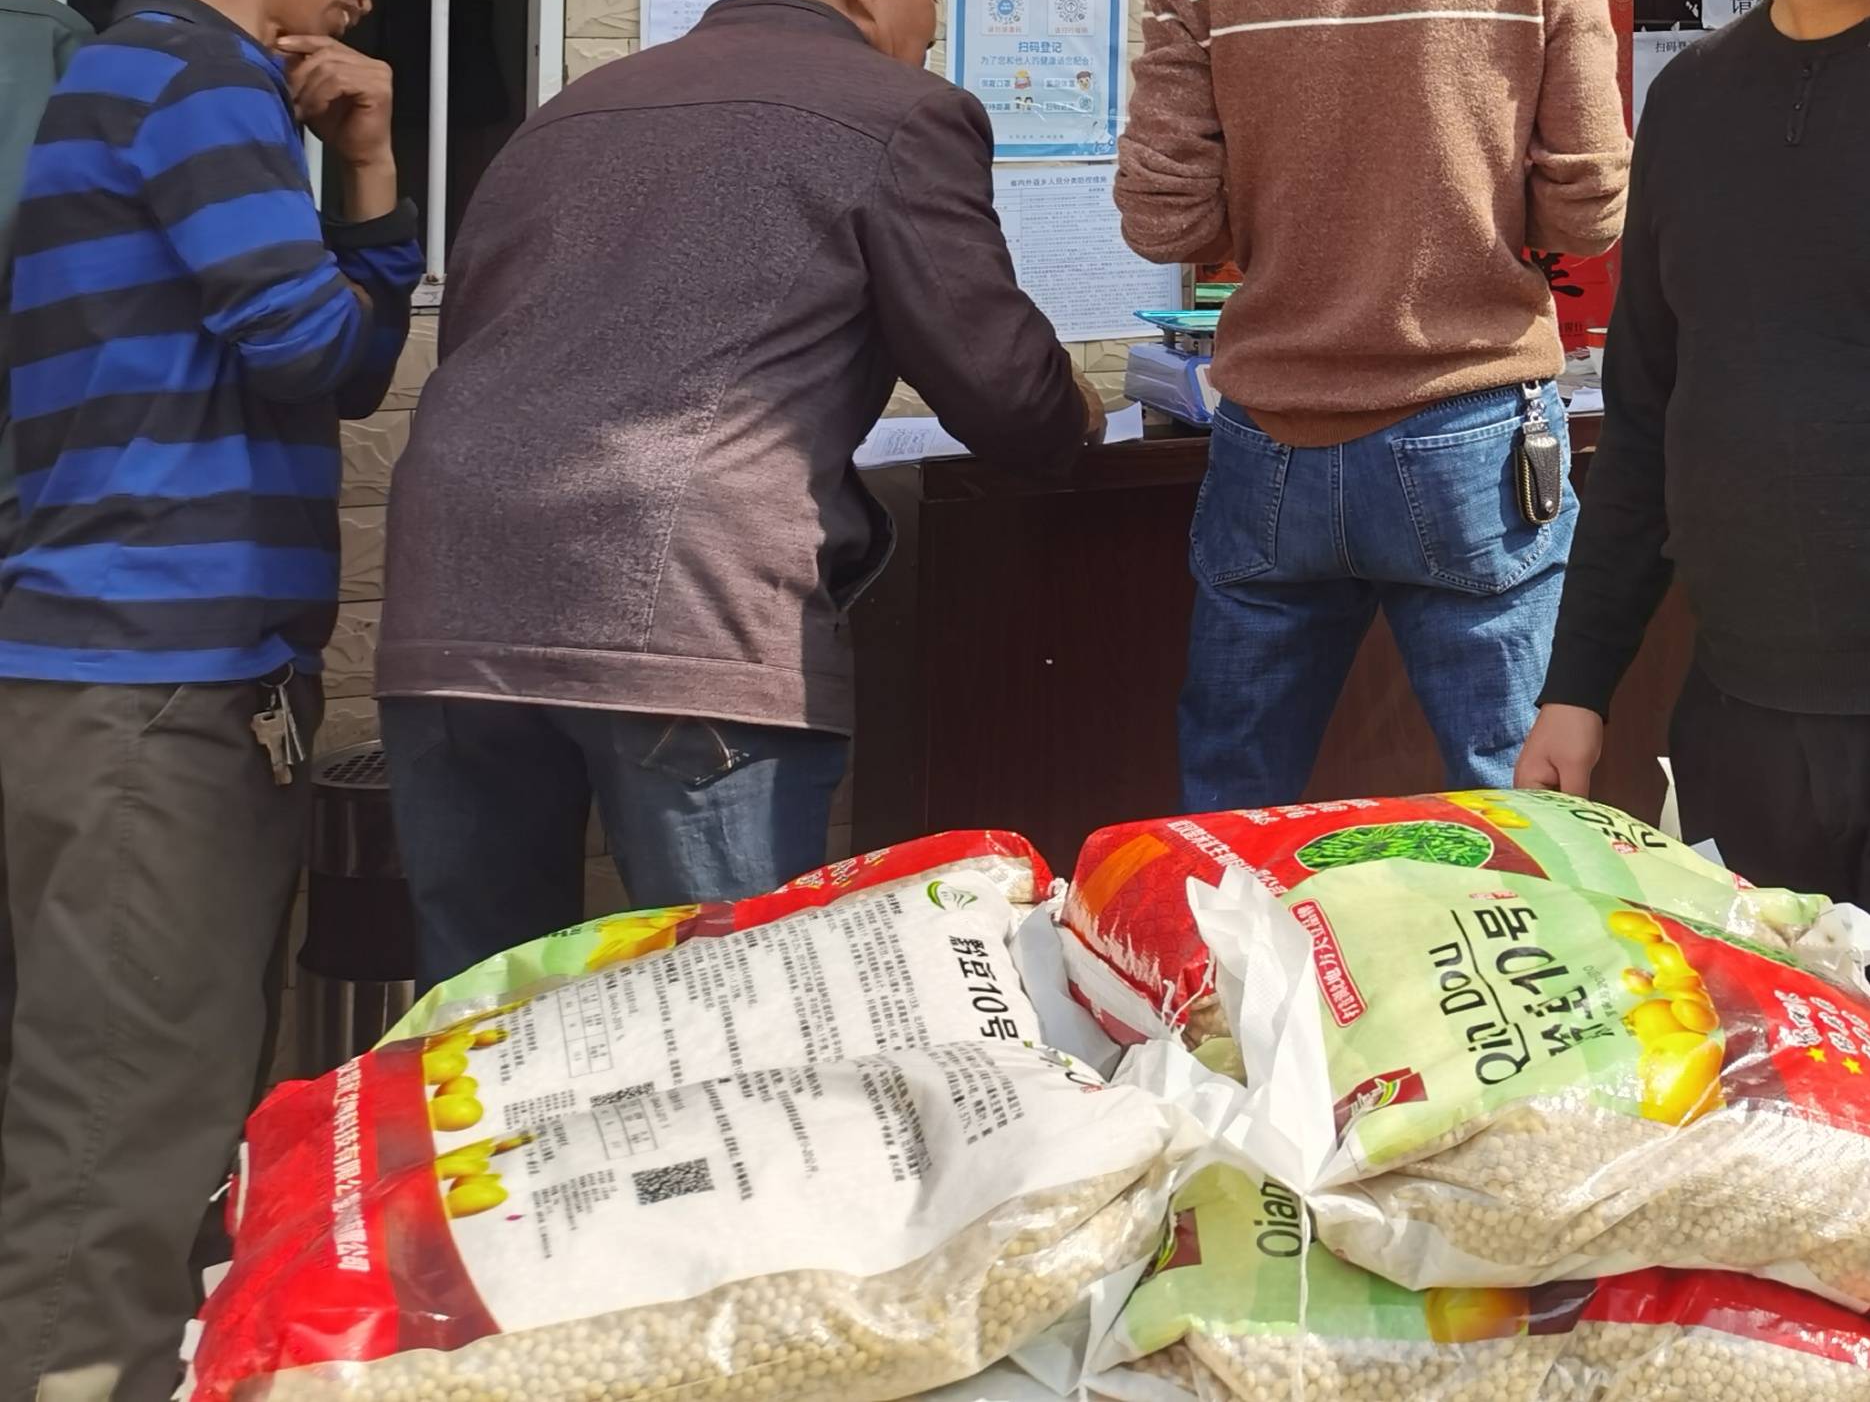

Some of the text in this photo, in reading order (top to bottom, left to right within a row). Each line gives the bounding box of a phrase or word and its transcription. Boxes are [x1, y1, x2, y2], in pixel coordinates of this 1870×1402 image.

[1018, 41, 1062, 54] 扫码登记
[948, 934, 1020, 1042] 黔豆10号
